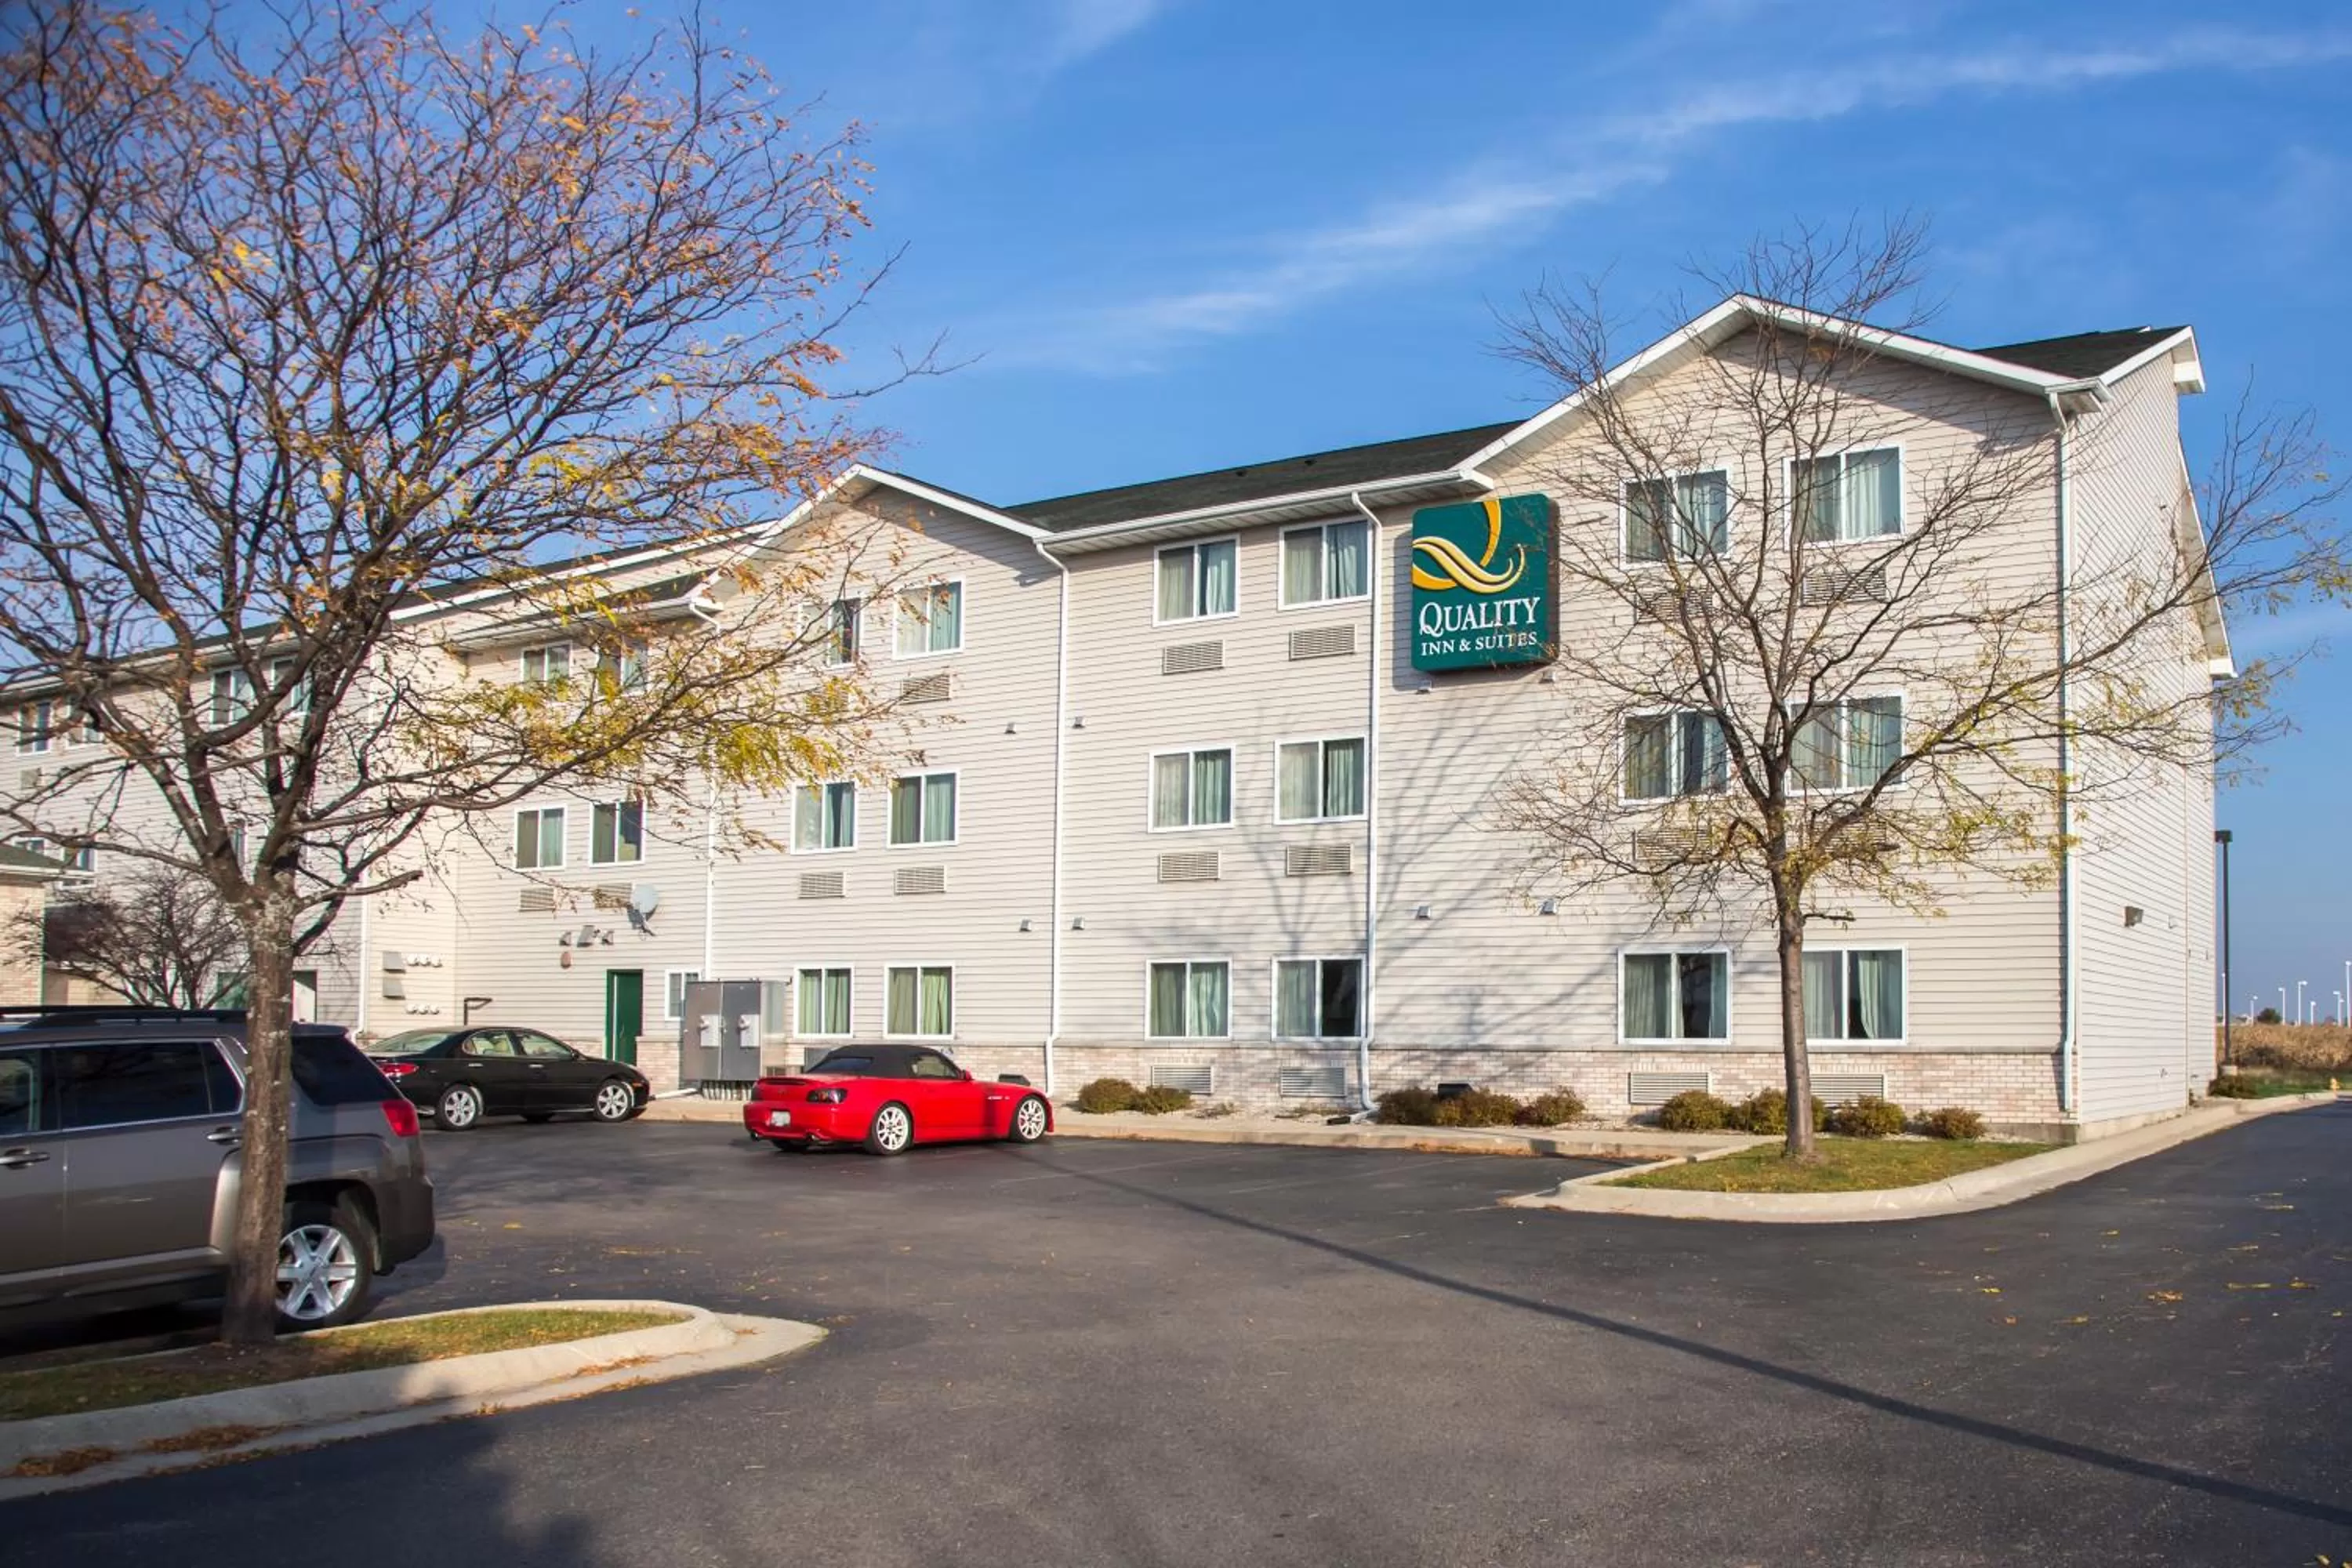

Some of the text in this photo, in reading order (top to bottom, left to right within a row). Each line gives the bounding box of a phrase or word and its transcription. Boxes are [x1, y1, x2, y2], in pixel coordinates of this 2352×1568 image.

[1419, 597, 1541, 637] QUALITY
[1421, 631, 1537, 656] INN & SUITES
